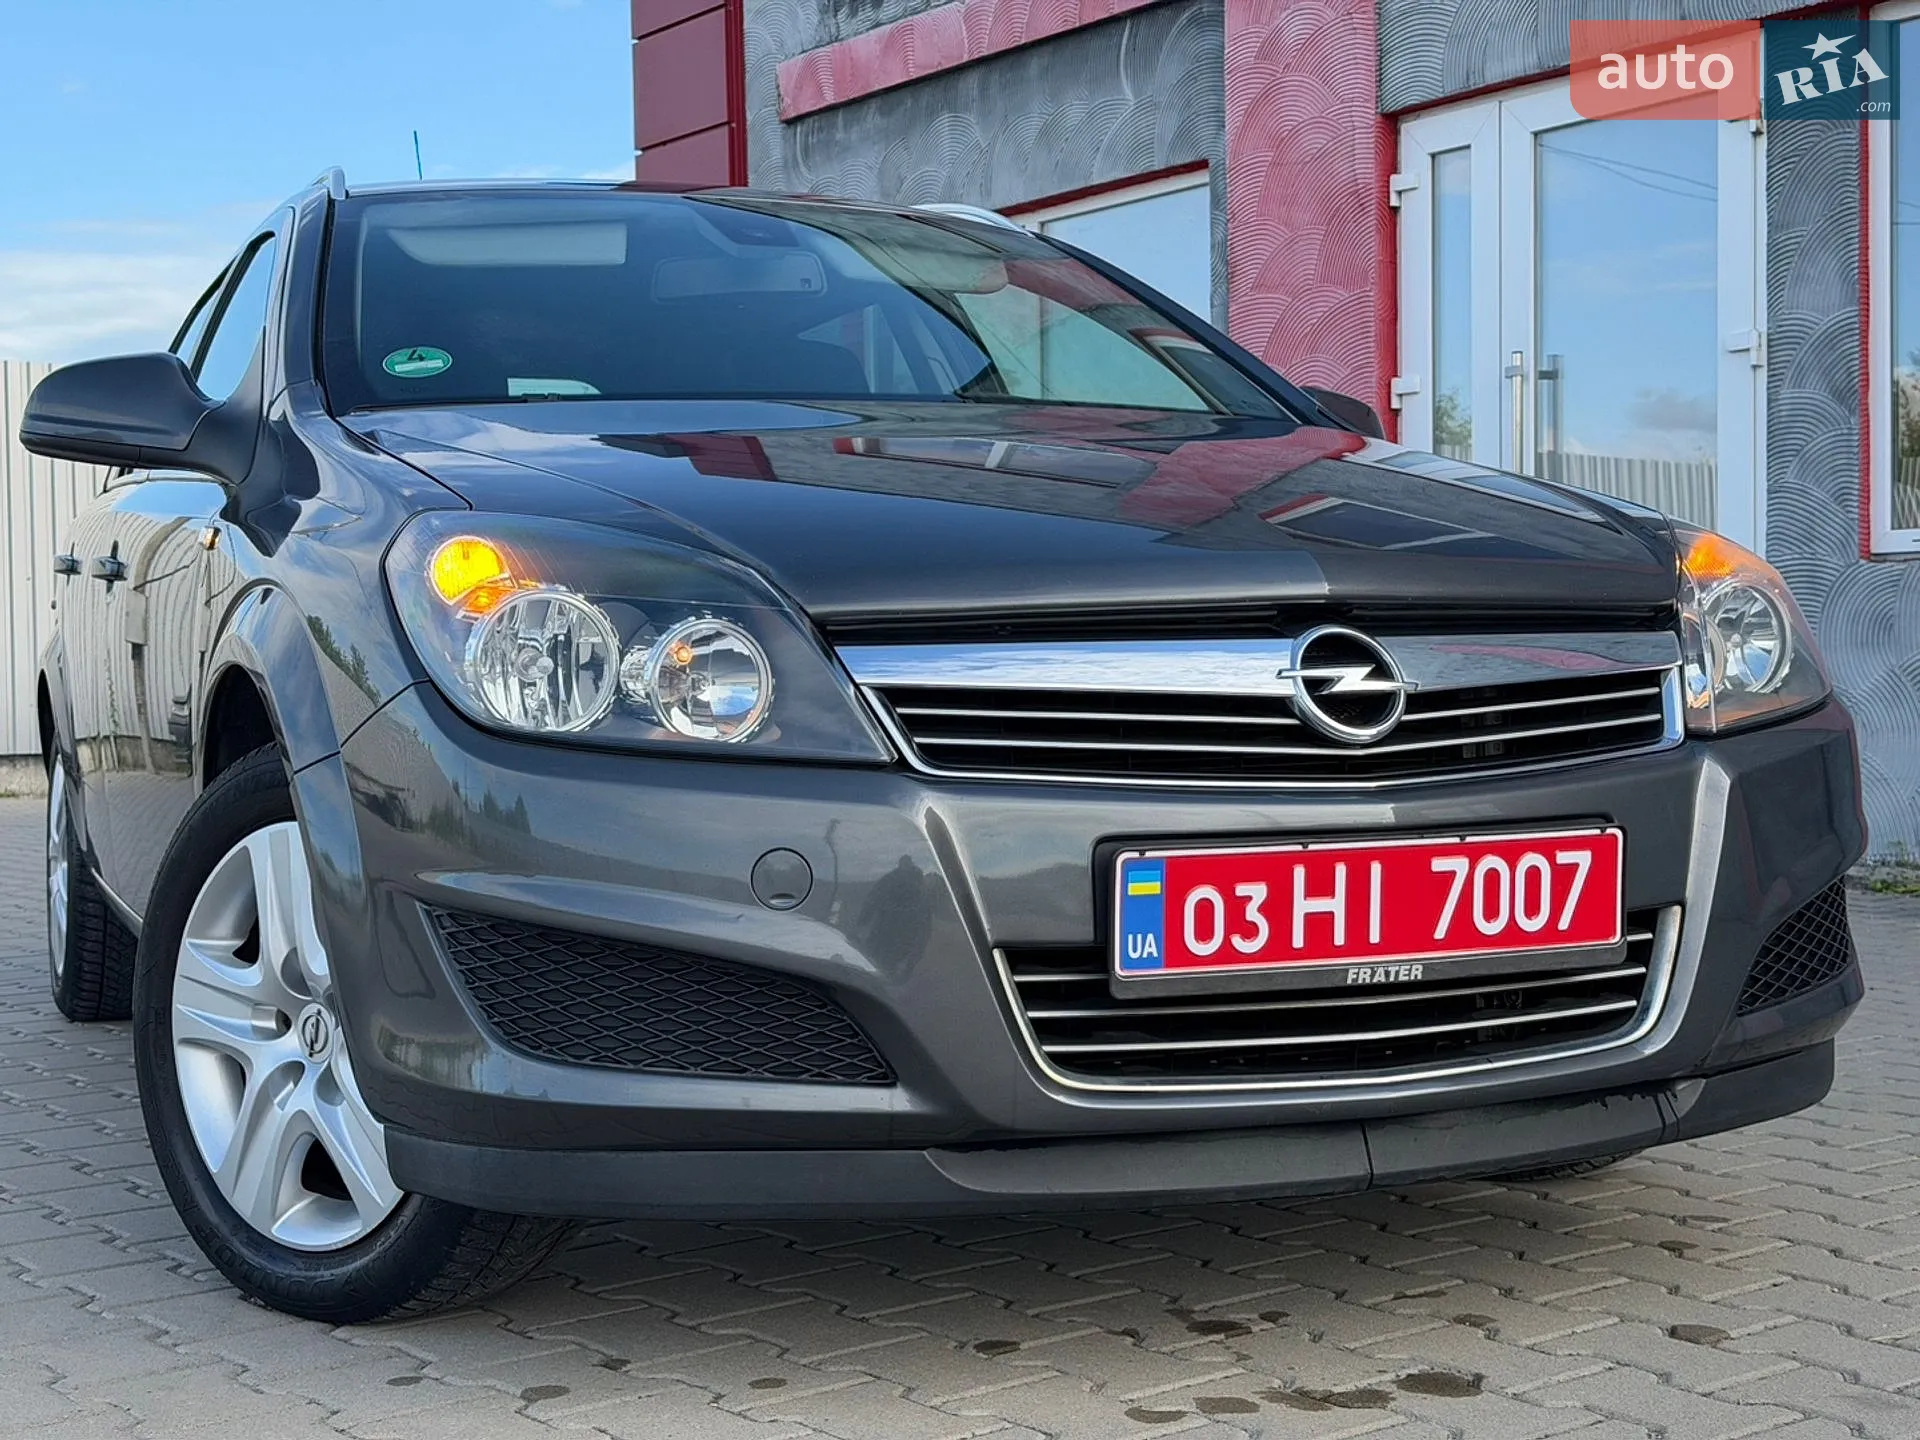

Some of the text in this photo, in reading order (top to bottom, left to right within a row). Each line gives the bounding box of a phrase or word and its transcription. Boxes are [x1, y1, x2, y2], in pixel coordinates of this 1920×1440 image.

[1183, 881, 1269, 956] 03
[1431, 850, 1592, 940] 7007
[1128, 933, 1158, 958] UA
